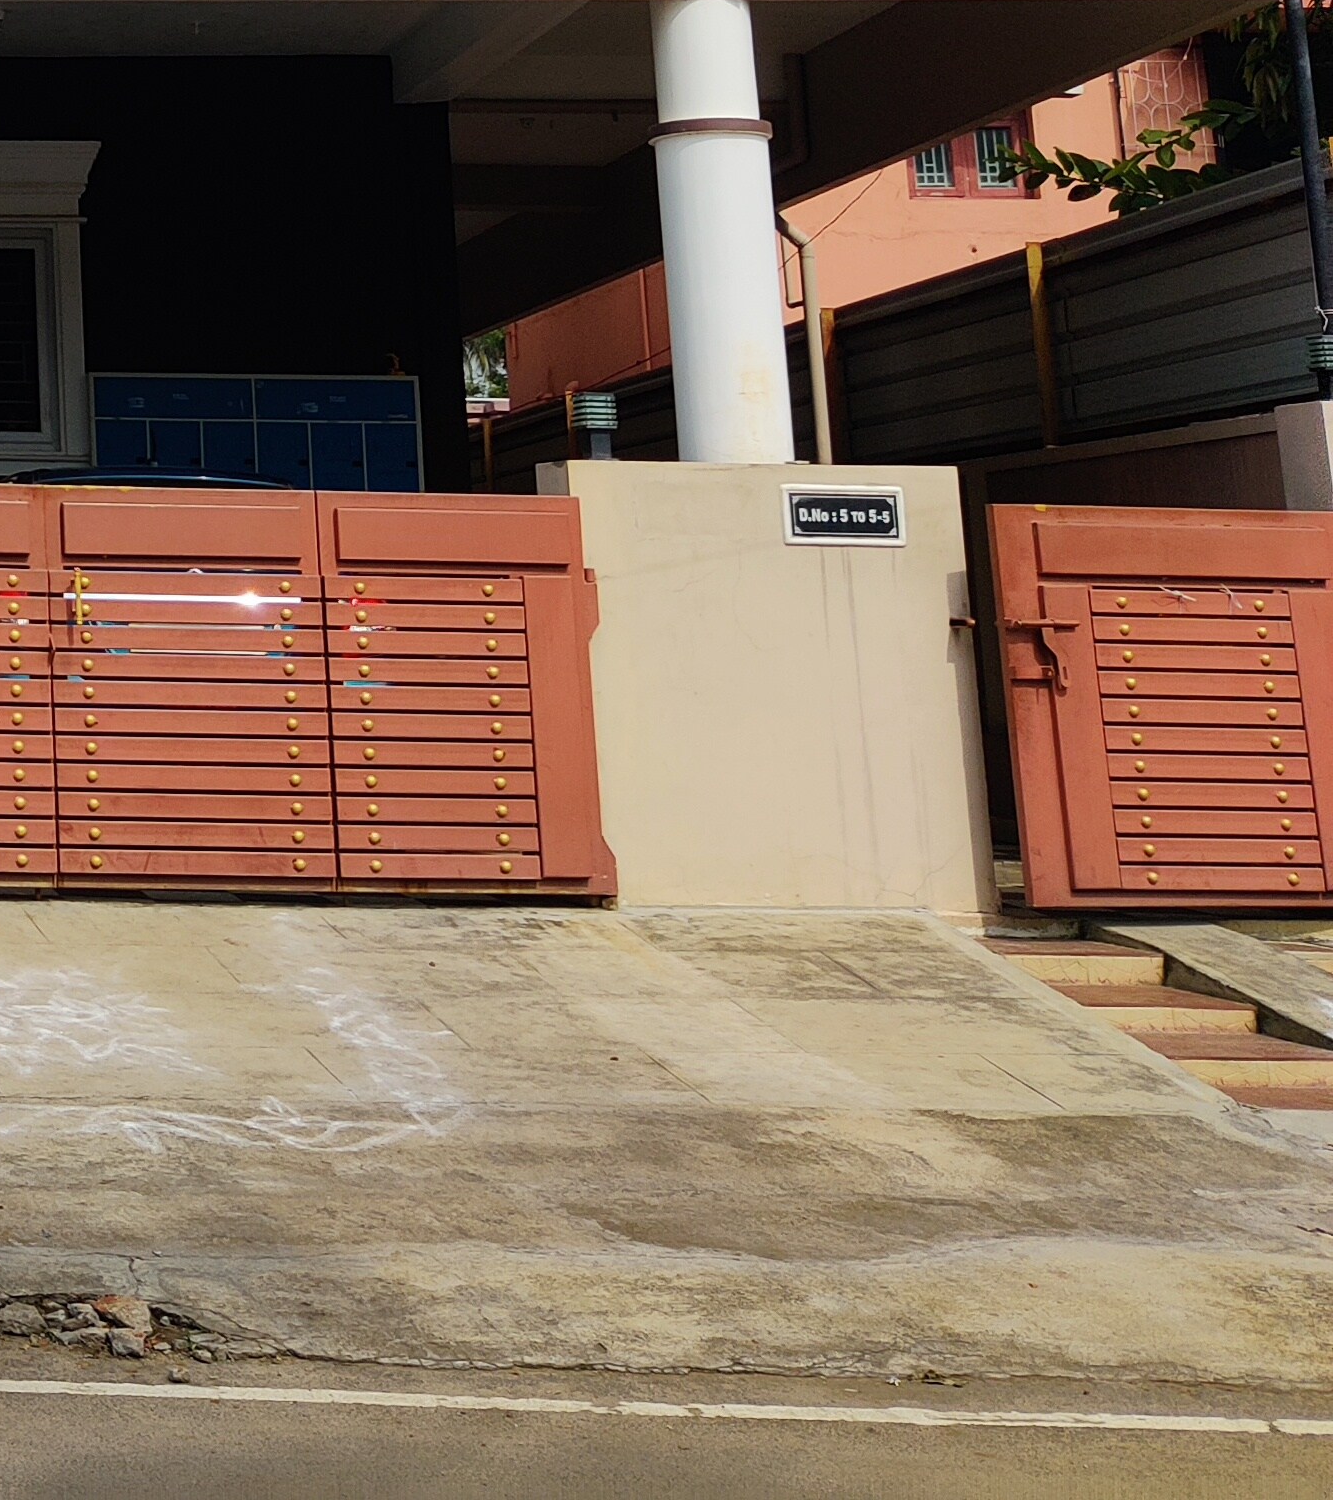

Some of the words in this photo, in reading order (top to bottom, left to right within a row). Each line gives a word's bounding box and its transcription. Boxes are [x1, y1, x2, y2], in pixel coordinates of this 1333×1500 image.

[799, 508, 829, 522] D.No
[840, 509, 848, 522] 5
[869, 509, 890, 523] 5-5
